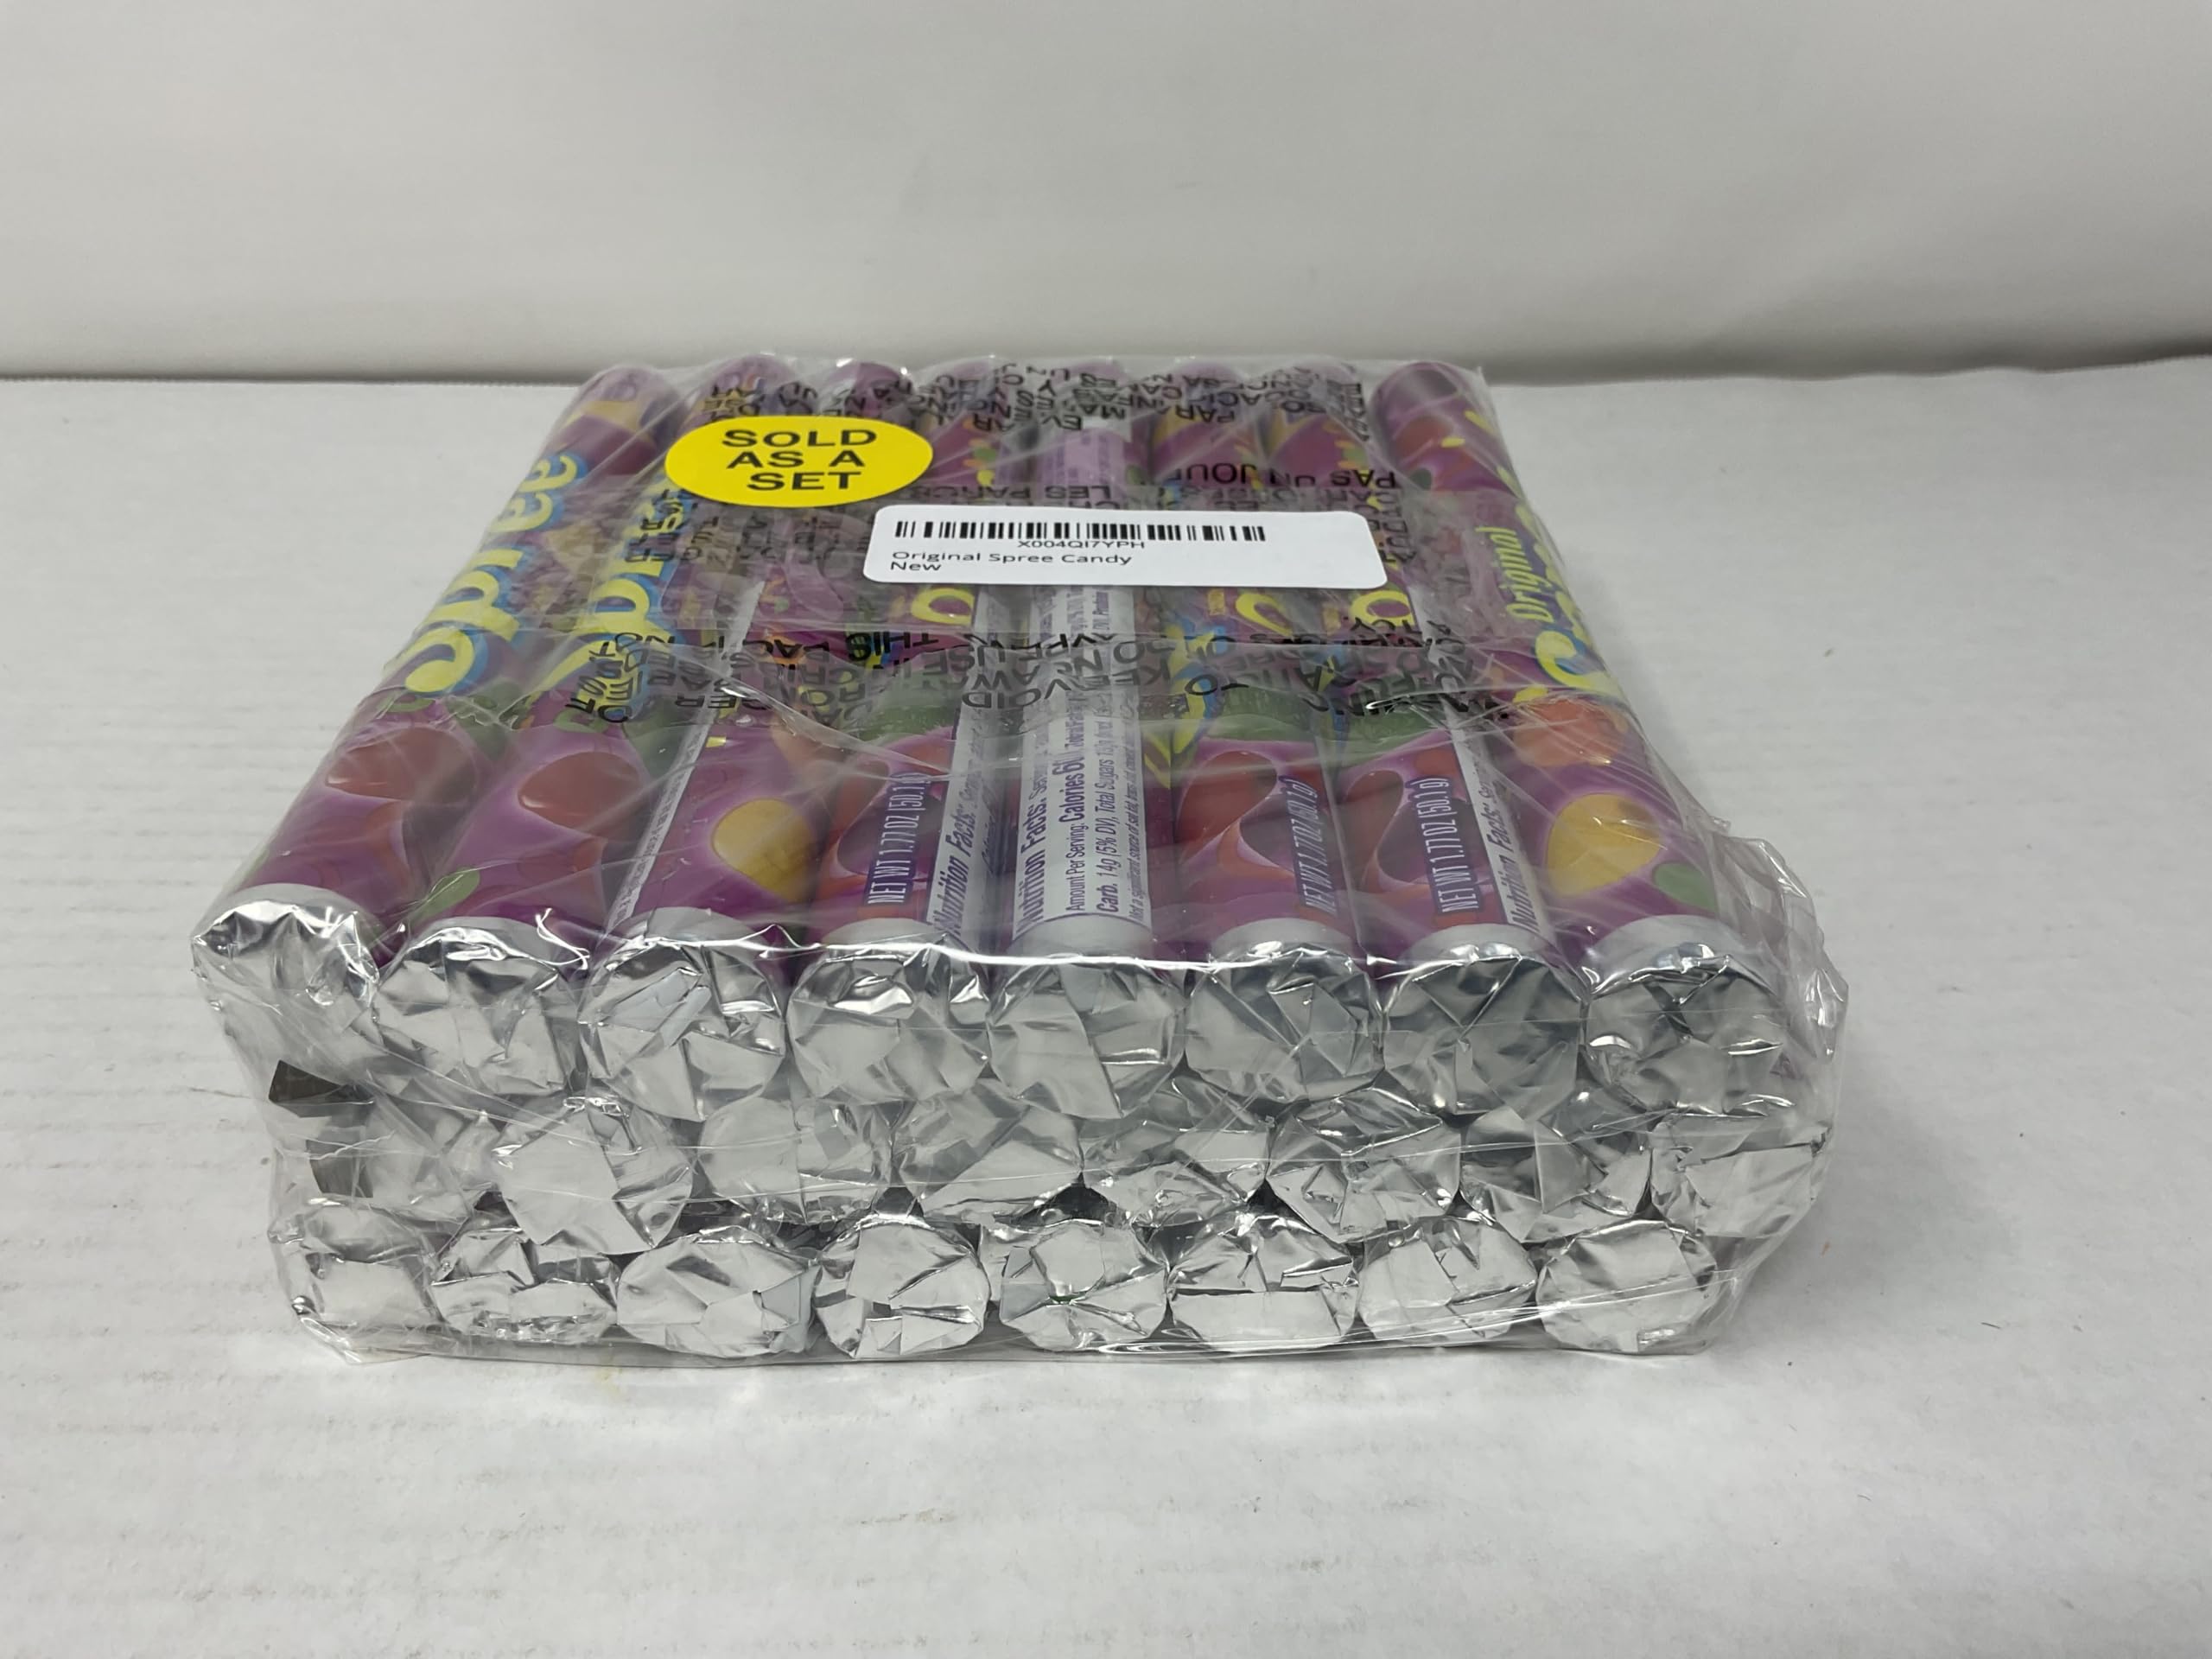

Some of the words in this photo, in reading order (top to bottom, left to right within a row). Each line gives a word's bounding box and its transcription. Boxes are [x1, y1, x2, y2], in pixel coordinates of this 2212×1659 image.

[721, 429, 878, 448] SOLD
[727, 450, 804, 469] AS
[829, 449, 867, 468] A
[747, 471, 861, 492] SET
[1329, 469, 1401, 490] PAS
[1016, 540, 1146, 550] X004QI7YPH
[890, 561, 942, 571] New
[891, 550, 982, 563] Original
[988, 553, 1054, 564] Spree
[1061, 553, 1134, 566] Candy
[384, 454, 579, 693] Spree
[1474, 525, 1555, 622] Original
[1093, 759, 1120, 790] Sugars
[1058, 773, 1085, 823] Calories
[1093, 791, 1116, 813] Total
[1413, 790, 1459, 818] (50.1
[881, 815, 920, 830] OZ
[1420, 818, 1459, 836] OZ
[877, 830, 917, 856] 1.77
[1065, 823, 1090, 858] Serving:
[1095, 837, 1122, 857] (5%
[1425, 838, 1466, 863] 1.77
[872, 859, 912, 879] WT
[1065, 860, 1086, 874] Per
[1095, 858, 1122, 878] 14g
[1298, 861, 1332, 889] WT
[1431, 865, 1472, 887] WT
[867, 881, 908, 905] NET
[932, 855, 969, 931] Nutrition
[1018, 849, 1046, 930] Nutrition
[1065, 874, 1086, 912] Amount
[1095, 883, 1120, 913] Carb.
[1302, 883, 1337, 914] NET
[1437, 887, 1480, 913] NET
[1498, 855, 1539, 933] Nutrition
